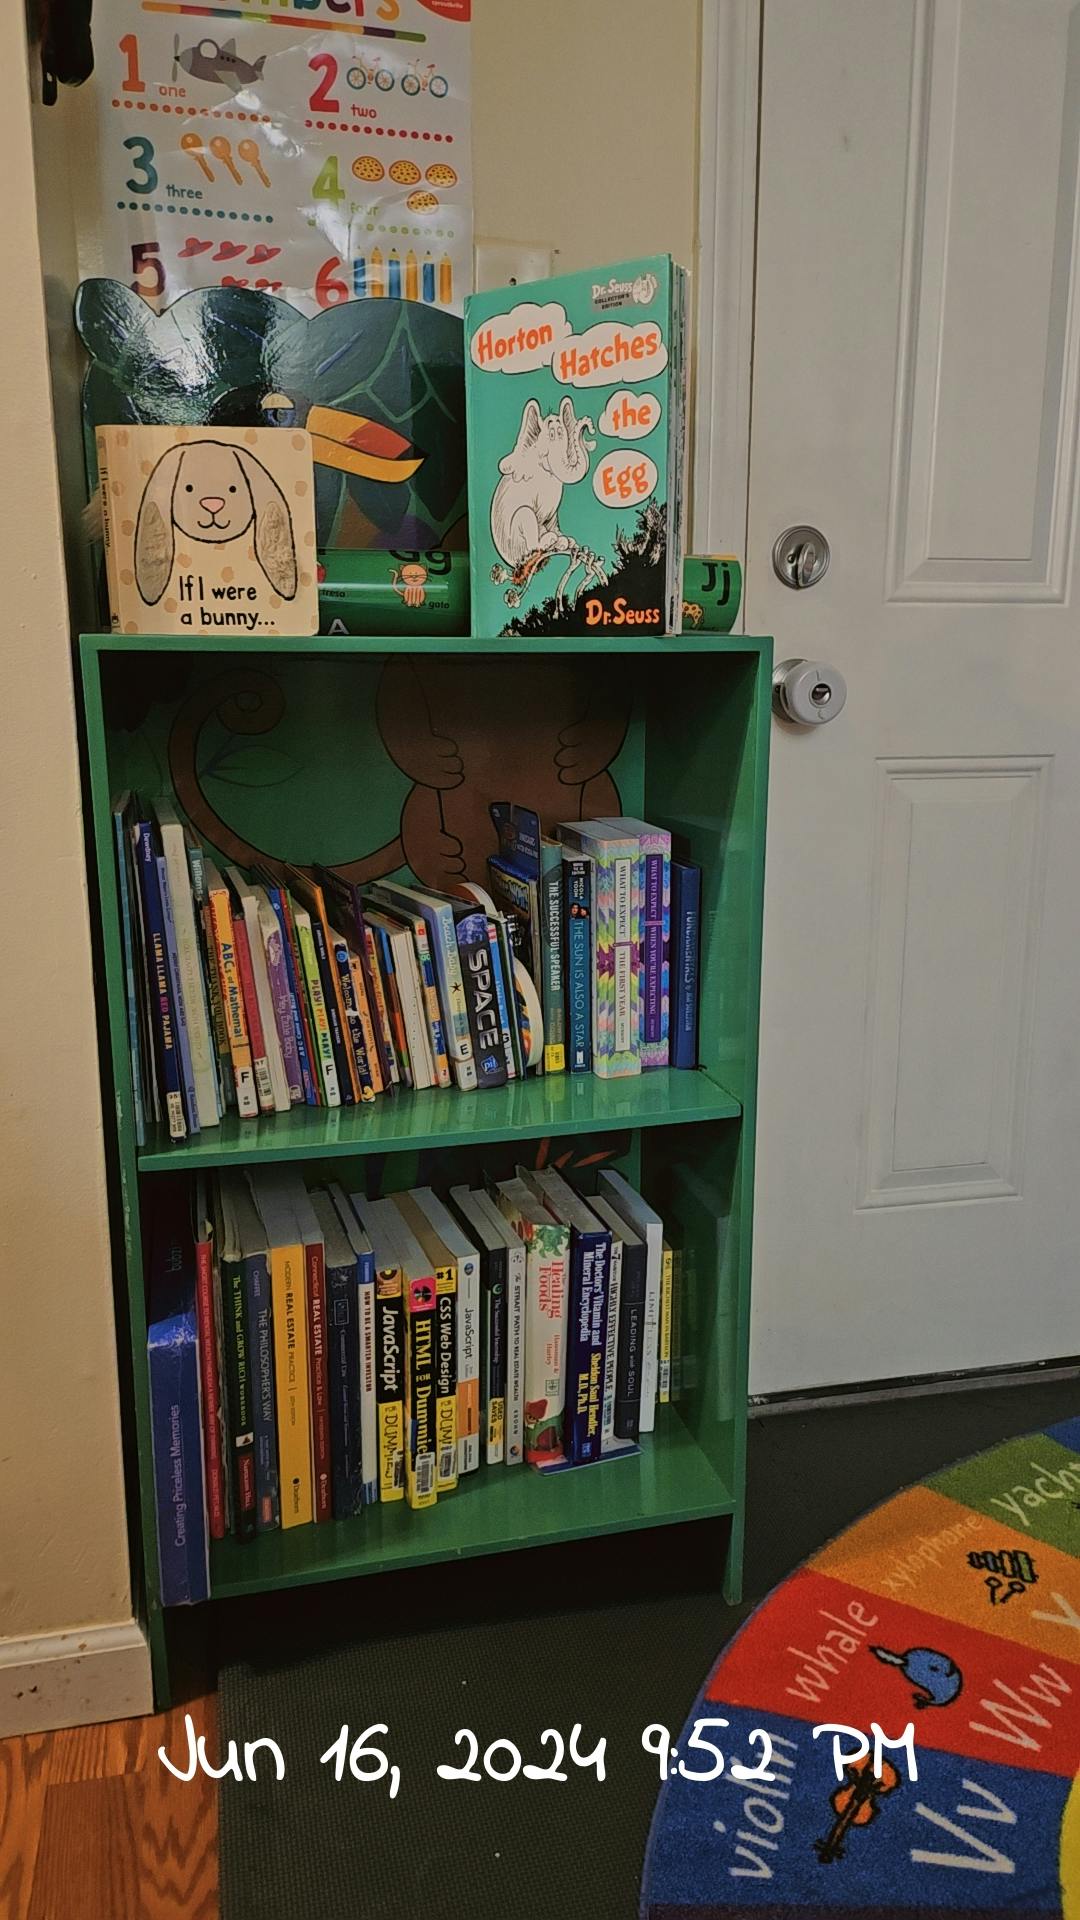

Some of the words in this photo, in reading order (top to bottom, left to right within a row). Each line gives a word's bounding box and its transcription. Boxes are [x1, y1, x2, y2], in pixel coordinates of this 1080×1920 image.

[119, 34, 146, 92] 1
[159, 84, 186, 97] one
[308, 53, 340, 113] 2
[351, 102, 377, 118] two
[123, 136, 158, 194] 3
[166, 184, 203, 199] three
[312, 156, 345, 206] 4
[131, 242, 166, 296] 5
[315, 256, 349, 308] 6
[592, 285, 606, 299] Dr.
[608, 279, 633, 293] Seuss
[477, 320, 553, 365] Horton
[560, 330, 658, 380] Hatches
[612, 399, 651, 431] the
[603, 462, 648, 499] Egg
[179, 575, 194, 601] If
[199, 575, 204, 601] I
[211, 585, 258, 601] were
[701, 562, 730, 606] Jj
[180, 611, 193, 626] a
[200, 608, 275, 630] bunny...
[585, 598, 611, 625] Dr.
[613, 601, 660, 625] Seuss
[143, 833, 152, 862] Dewdney
[192, 860, 203, 894] Willems
[549, 881, 559, 897] THE
[650, 882, 657, 892] TO
[619, 891, 626, 903] TO
[441, 917, 455, 948] Beach
[549, 900, 560, 953] SUCCESSFUL
[574, 921, 584, 940] THE
[153, 933, 165, 962] LLAMA
[221, 943, 234, 973] ABCs
[574, 943, 584, 966] SUN
[685, 911, 697, 983] FUNDAMENTALS
[445, 950, 458, 976] Baby
[550, 954, 561, 992] SPEAKER
[574, 970, 584, 979] IS
[156, 964, 168, 994] LLAMA
[311, 980, 322, 1006] PLAY!
[468, 949, 499, 1050] SPACE
[575, 982, 584, 1010] ALSO
[316, 1008, 327, 1031] PLAY!
[575, 1013, 585, 1021] A
[162, 1015, 173, 1050] PAJAMA
[321, 1032, 332, 1059] PLAY!
[353, 1028, 362, 1043] the
[575, 1024, 585, 1047] STAR
[355, 1047, 369, 1075] World!
[460, 1044, 468, 1055] E
[241, 1072, 249, 1084] F
[325, 1064, 334, 1075] F
[596, 1242, 606, 1259] The
[232, 1275, 241, 1288] The
[437, 1268, 453, 1281] #1
[582, 1251, 594, 1285] Mineral
[594, 1260, 605, 1294] Doctors'
[286, 1292, 294, 1315] REAL
[538, 1266, 552, 1311] Foods
[548, 1261, 565, 1319] Healing
[608, 1282, 619, 1313] HIGHLY
[233, 1291, 242, 1319] THINK
[258, 1309, 268, 1328] THE
[313, 1299, 321, 1322] REAL
[440, 1297, 452, 1320] CSS
[579, 1287, 593, 1342] Encyclopedia
[592, 1294, 604, 1328] Vitamin
[287, 1318, 295, 1349] ESTATE
[314, 1324, 322, 1354] ESTATE
[416, 1319, 431, 1370] HTML
[440, 1323, 452, 1349] Web
[462, 1308, 474, 1359] JavaScript
[514, 1337, 520, 1345] TO
[592, 1330, 602, 1346] and
[606, 1314, 617, 1360] EFFECTIVE
[629, 1309, 638, 1352] LEADING
[236, 1334, 245, 1359] GROW
[380, 1306, 400, 1391] JavaScript
[238, 1361, 246, 1382] RICH
[259, 1330, 271, 1399] PHILOSOPHER'S
[438, 1352, 452, 1394] Design
[590, 1352, 601, 1384] Sheldon
[577, 1373, 589, 1393] M.D.,
[588, 1385, 600, 1402] Saul
[627, 1370, 635, 1397] SOUL
[262, 1400, 272, 1421] WAY
[577, 1394, 588, 1414] Ph.D.
[168, 1405, 181, 1457] Memories
[416, 1385, 432, 1455] Dummie
[587, 1404, 599, 1437] Hendler,
[172, 1458, 184, 1502] Priceless
[174, 1503, 187, 1547] Creating
[881, 1514, 983, 1594] xylophone
[785, 1599, 879, 1705] whale
[968, 1662, 1073, 1753] Ww
[713, 1732, 800, 1880] violin
[910, 1778, 1018, 1875] Vv
